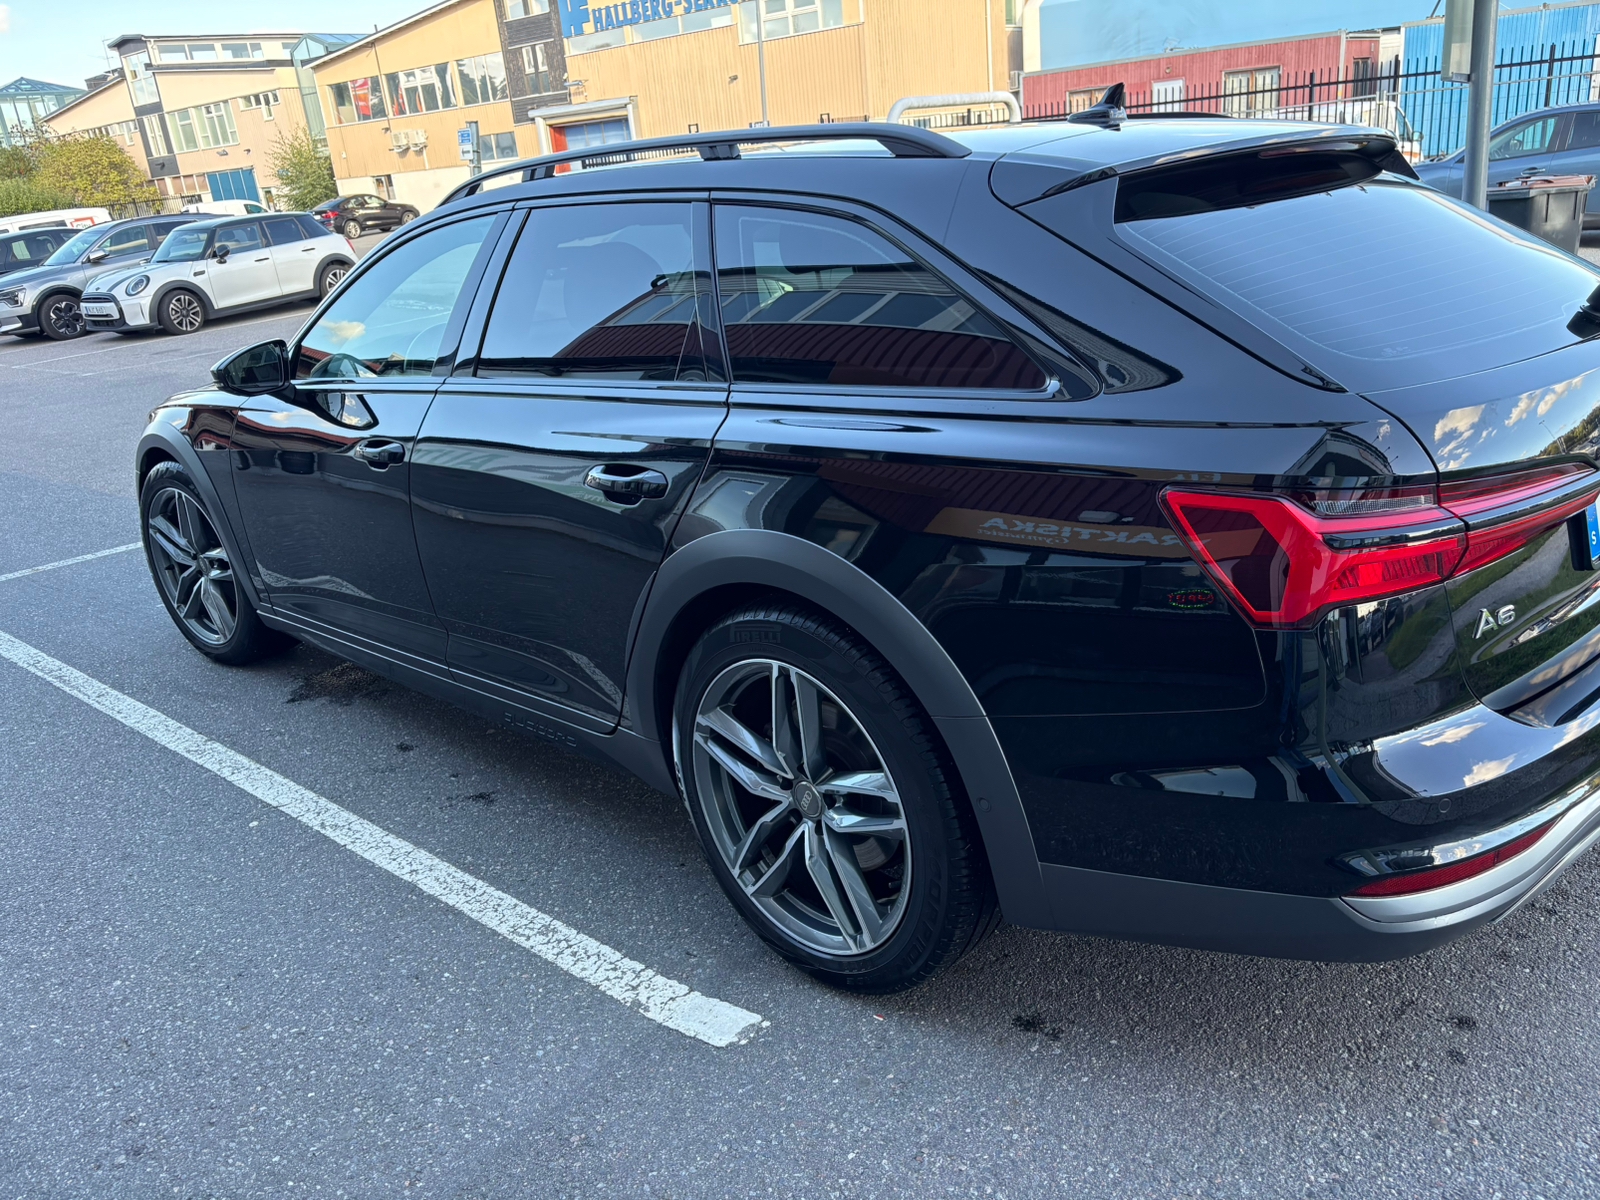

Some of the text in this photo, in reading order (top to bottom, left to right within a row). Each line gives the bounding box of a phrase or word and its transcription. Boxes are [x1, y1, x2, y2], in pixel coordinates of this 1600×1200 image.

[1591, 531, 1597, 545] S
[1472, 604, 1516, 639] A6
[729, 624, 782, 643] PIRELLI
